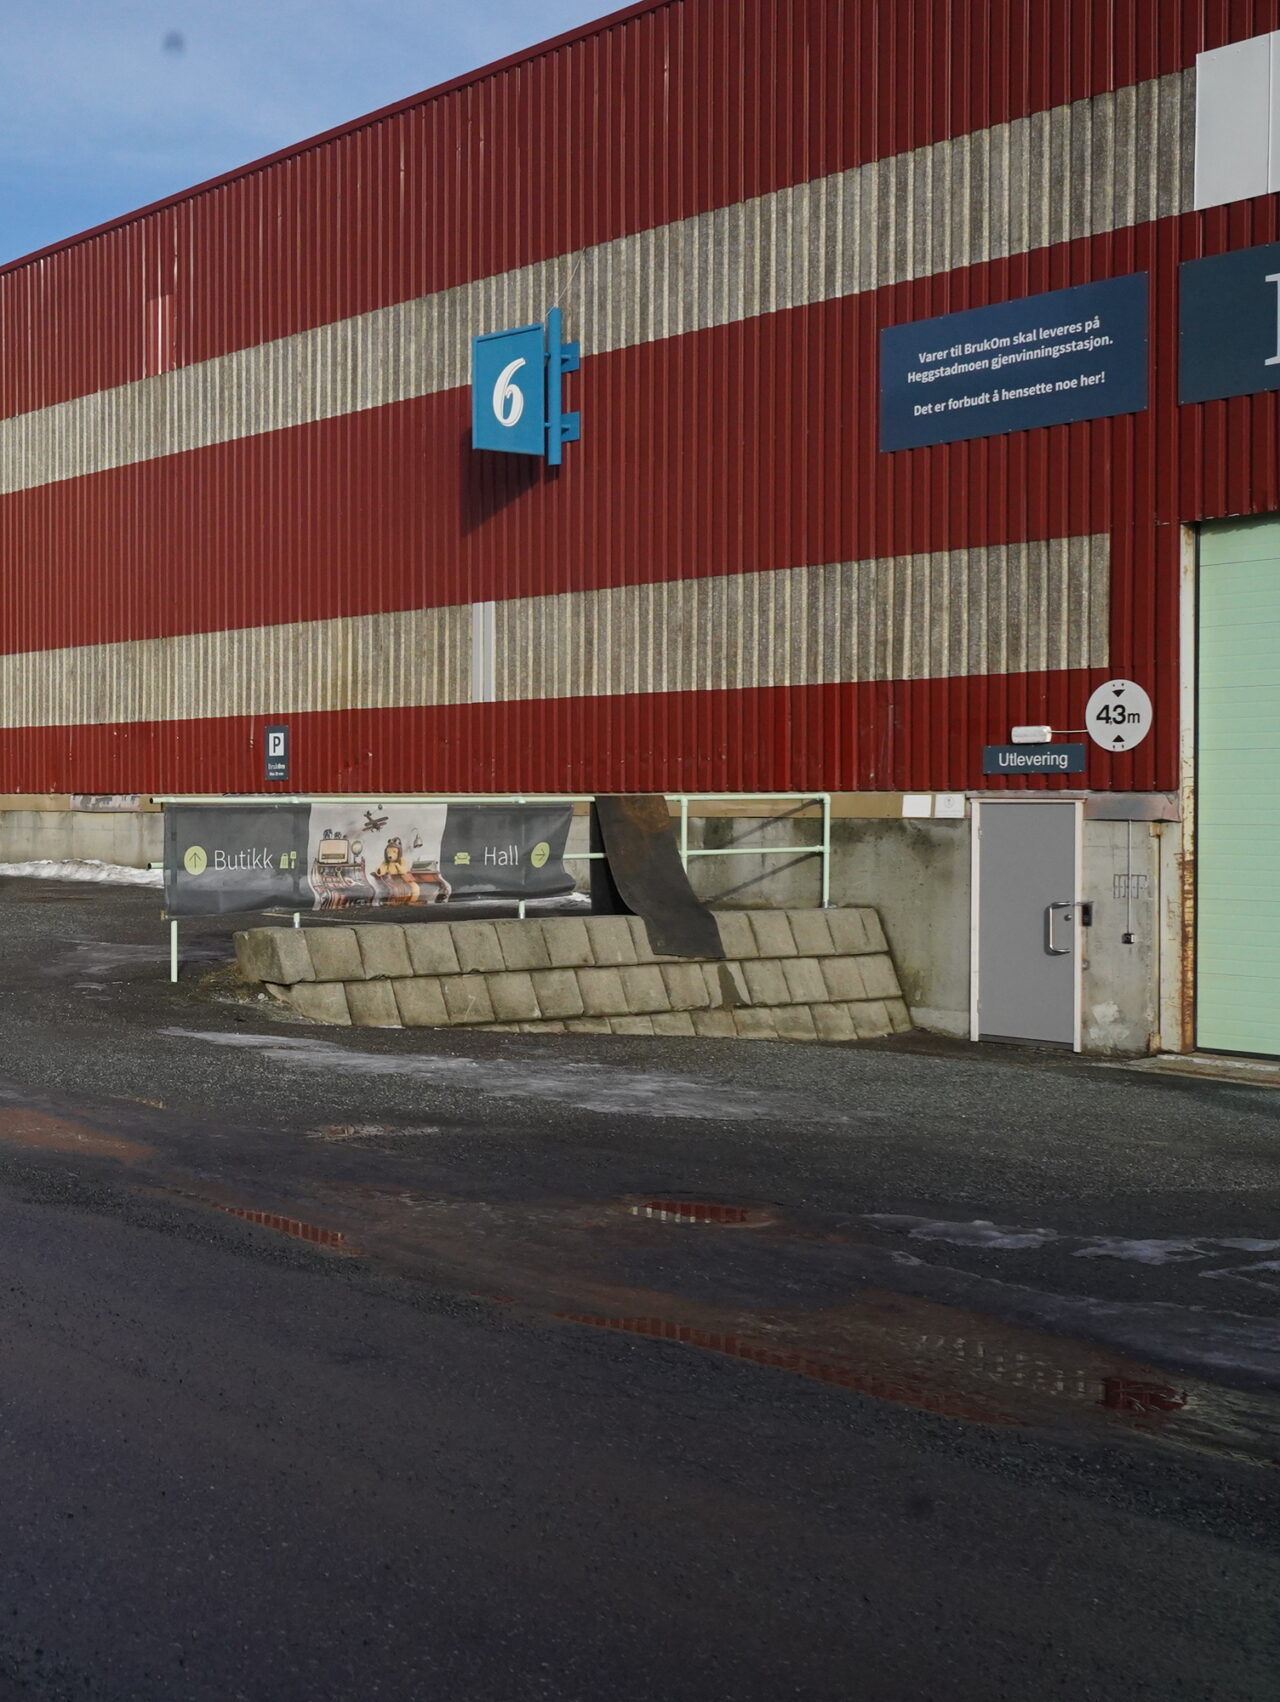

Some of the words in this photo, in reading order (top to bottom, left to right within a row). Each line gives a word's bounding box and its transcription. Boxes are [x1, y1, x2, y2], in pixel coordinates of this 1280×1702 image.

[918, 348, 949, 364] Varer
[950, 342, 962, 358] til
[963, 335, 1011, 355] BrukOm
[1012, 328, 1037, 345] skal
[1038, 321, 1083, 341] leveres
[1084, 315, 1100, 338] på
[907, 356, 989, 384] Heggstadmoen
[990, 334, 1114, 370] gjenvinningsstasjon.
[493, 357, 526, 427] 6
[913, 402, 932, 417] Det
[933, 402, 946, 413] er
[947, 392, 990, 410] forbudt
[991, 388, 1000, 402] å
[1001, 380, 1053, 400] hensette
[1054, 376, 1078, 392] noe
[1079, 371, 1106, 389] her!
[273, 735, 281, 753] P
[998, 752, 1069, 770] Utlevering
[214, 849, 274, 871] Butikk
[483, 845, 520, 867] Hall
